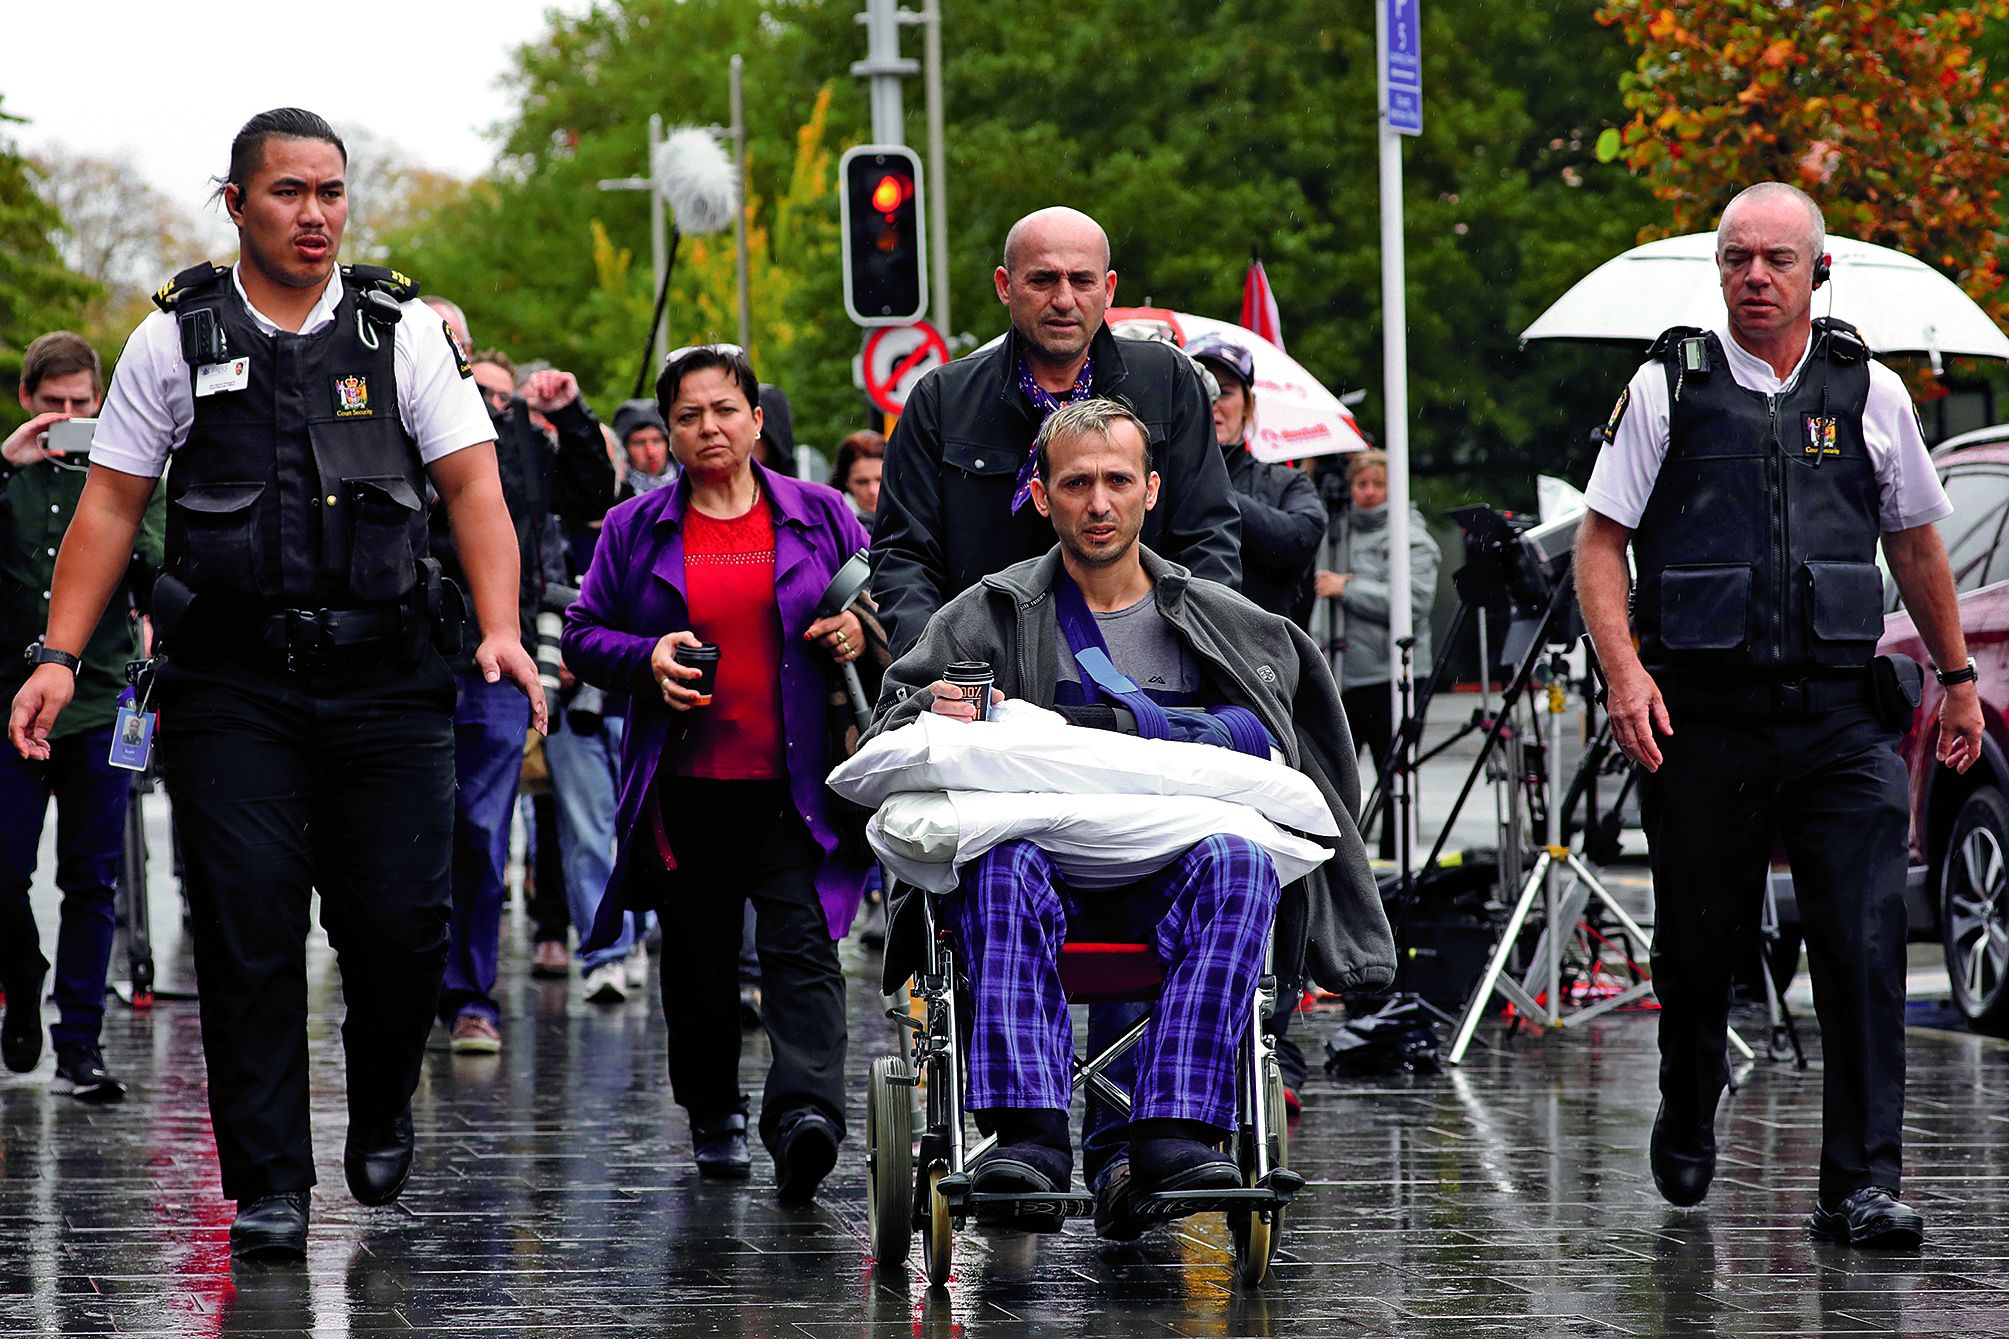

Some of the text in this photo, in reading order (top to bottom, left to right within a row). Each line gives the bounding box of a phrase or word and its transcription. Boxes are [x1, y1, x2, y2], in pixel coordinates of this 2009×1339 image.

[336, 409, 352, 417] Court
[1822, 447, 1841, 455] ecurity
[961, 686, 982, 698] 00%
